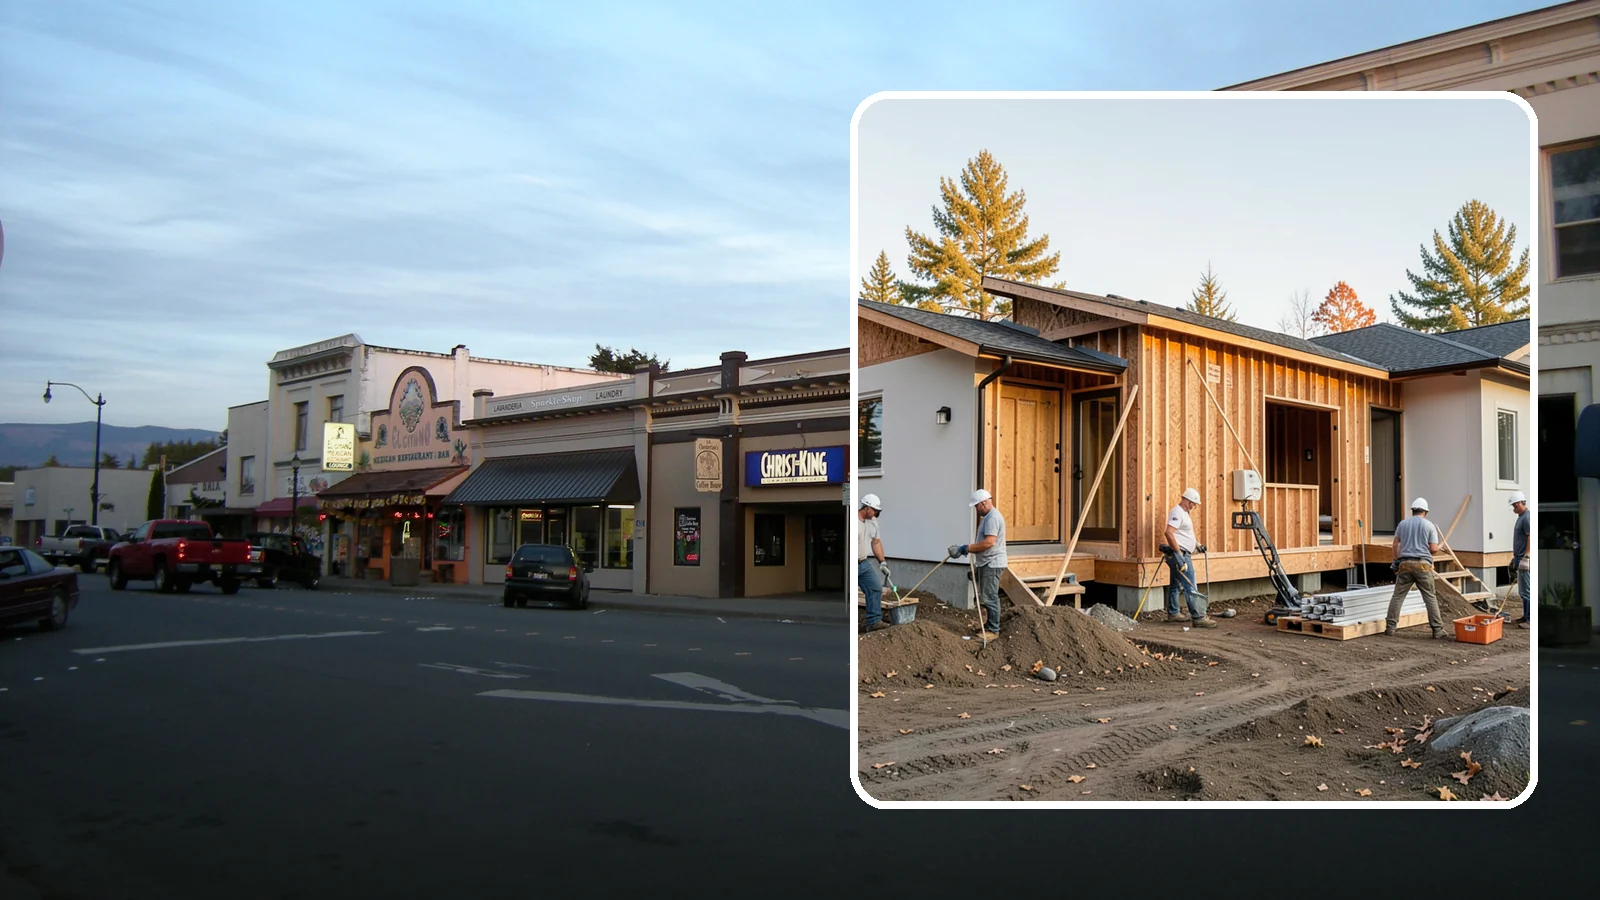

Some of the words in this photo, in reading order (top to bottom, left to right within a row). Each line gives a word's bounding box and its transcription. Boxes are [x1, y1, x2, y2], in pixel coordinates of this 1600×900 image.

[493, 402, 522, 412] LAVANDERIA
[531, 396, 561, 409] Sparkle
[561, 394, 582, 405] Shop
[595, 388, 624, 400] LAUNDRY
[373, 454, 397, 464] MEXICAN
[397, 451, 433, 463] RESTAURANT
[438, 450, 450, 459] BAR
[761, 452, 797, 478] CHRIST
[799, 449, 828, 477] KING
[696, 481, 709, 489] Coffee
[710, 481, 722, 489] House
